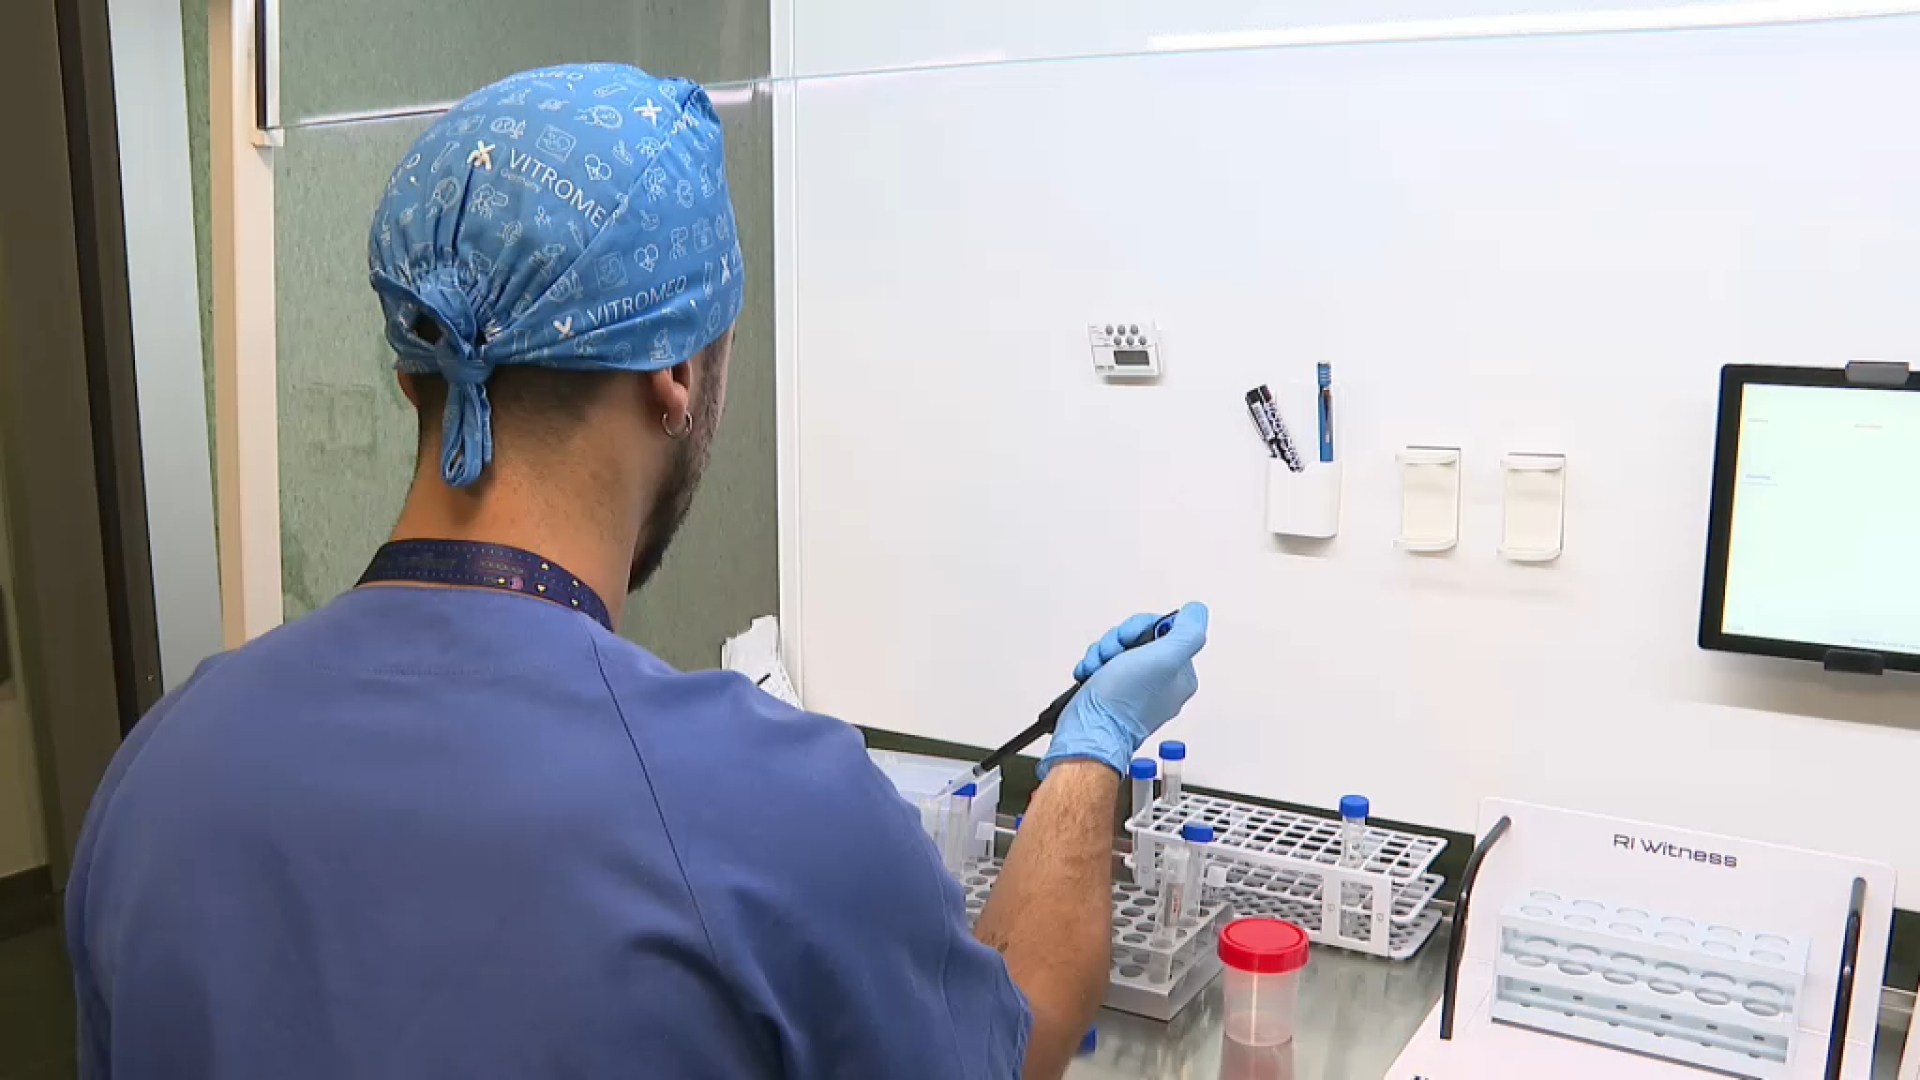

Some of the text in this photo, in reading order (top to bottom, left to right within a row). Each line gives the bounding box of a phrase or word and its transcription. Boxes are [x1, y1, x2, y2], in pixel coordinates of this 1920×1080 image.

[586, 275, 688, 326] VITROMED
[1613, 833, 1737, 868] RI Witness
